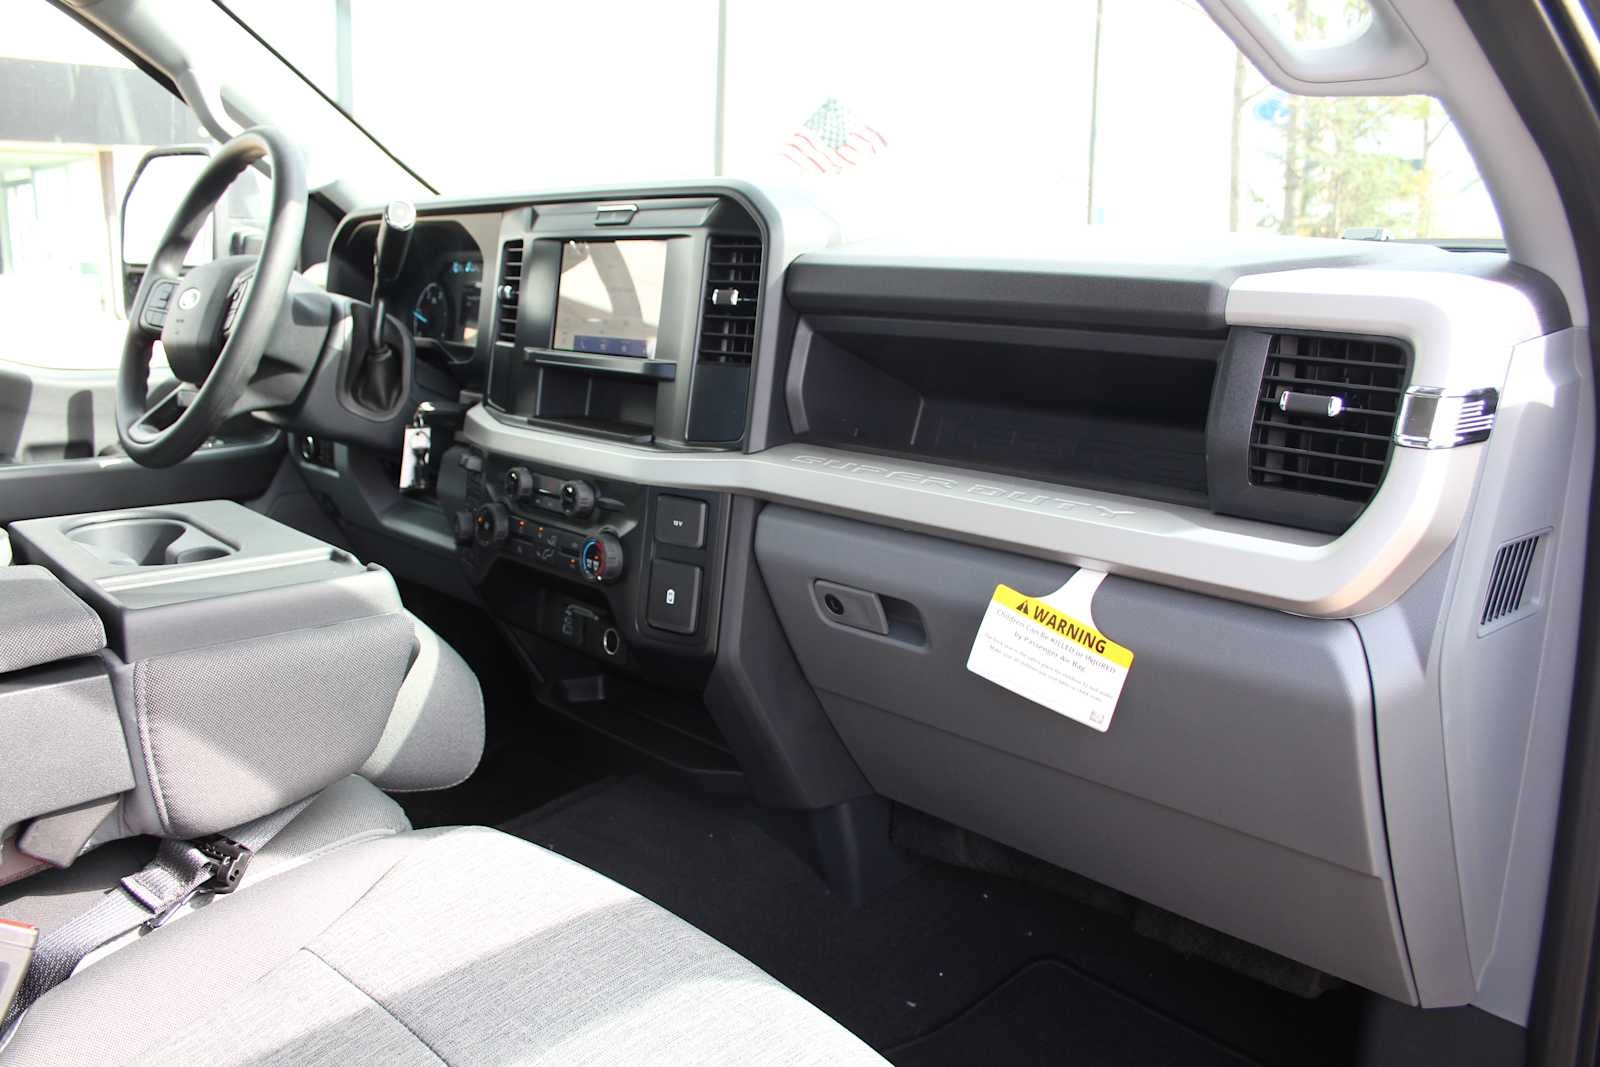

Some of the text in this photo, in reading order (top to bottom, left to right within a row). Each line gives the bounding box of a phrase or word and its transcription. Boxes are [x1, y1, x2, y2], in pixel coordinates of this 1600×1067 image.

[791, 454, 1136, 520] SUPER DUTY
[1033, 605, 1107, 654] WARNING
